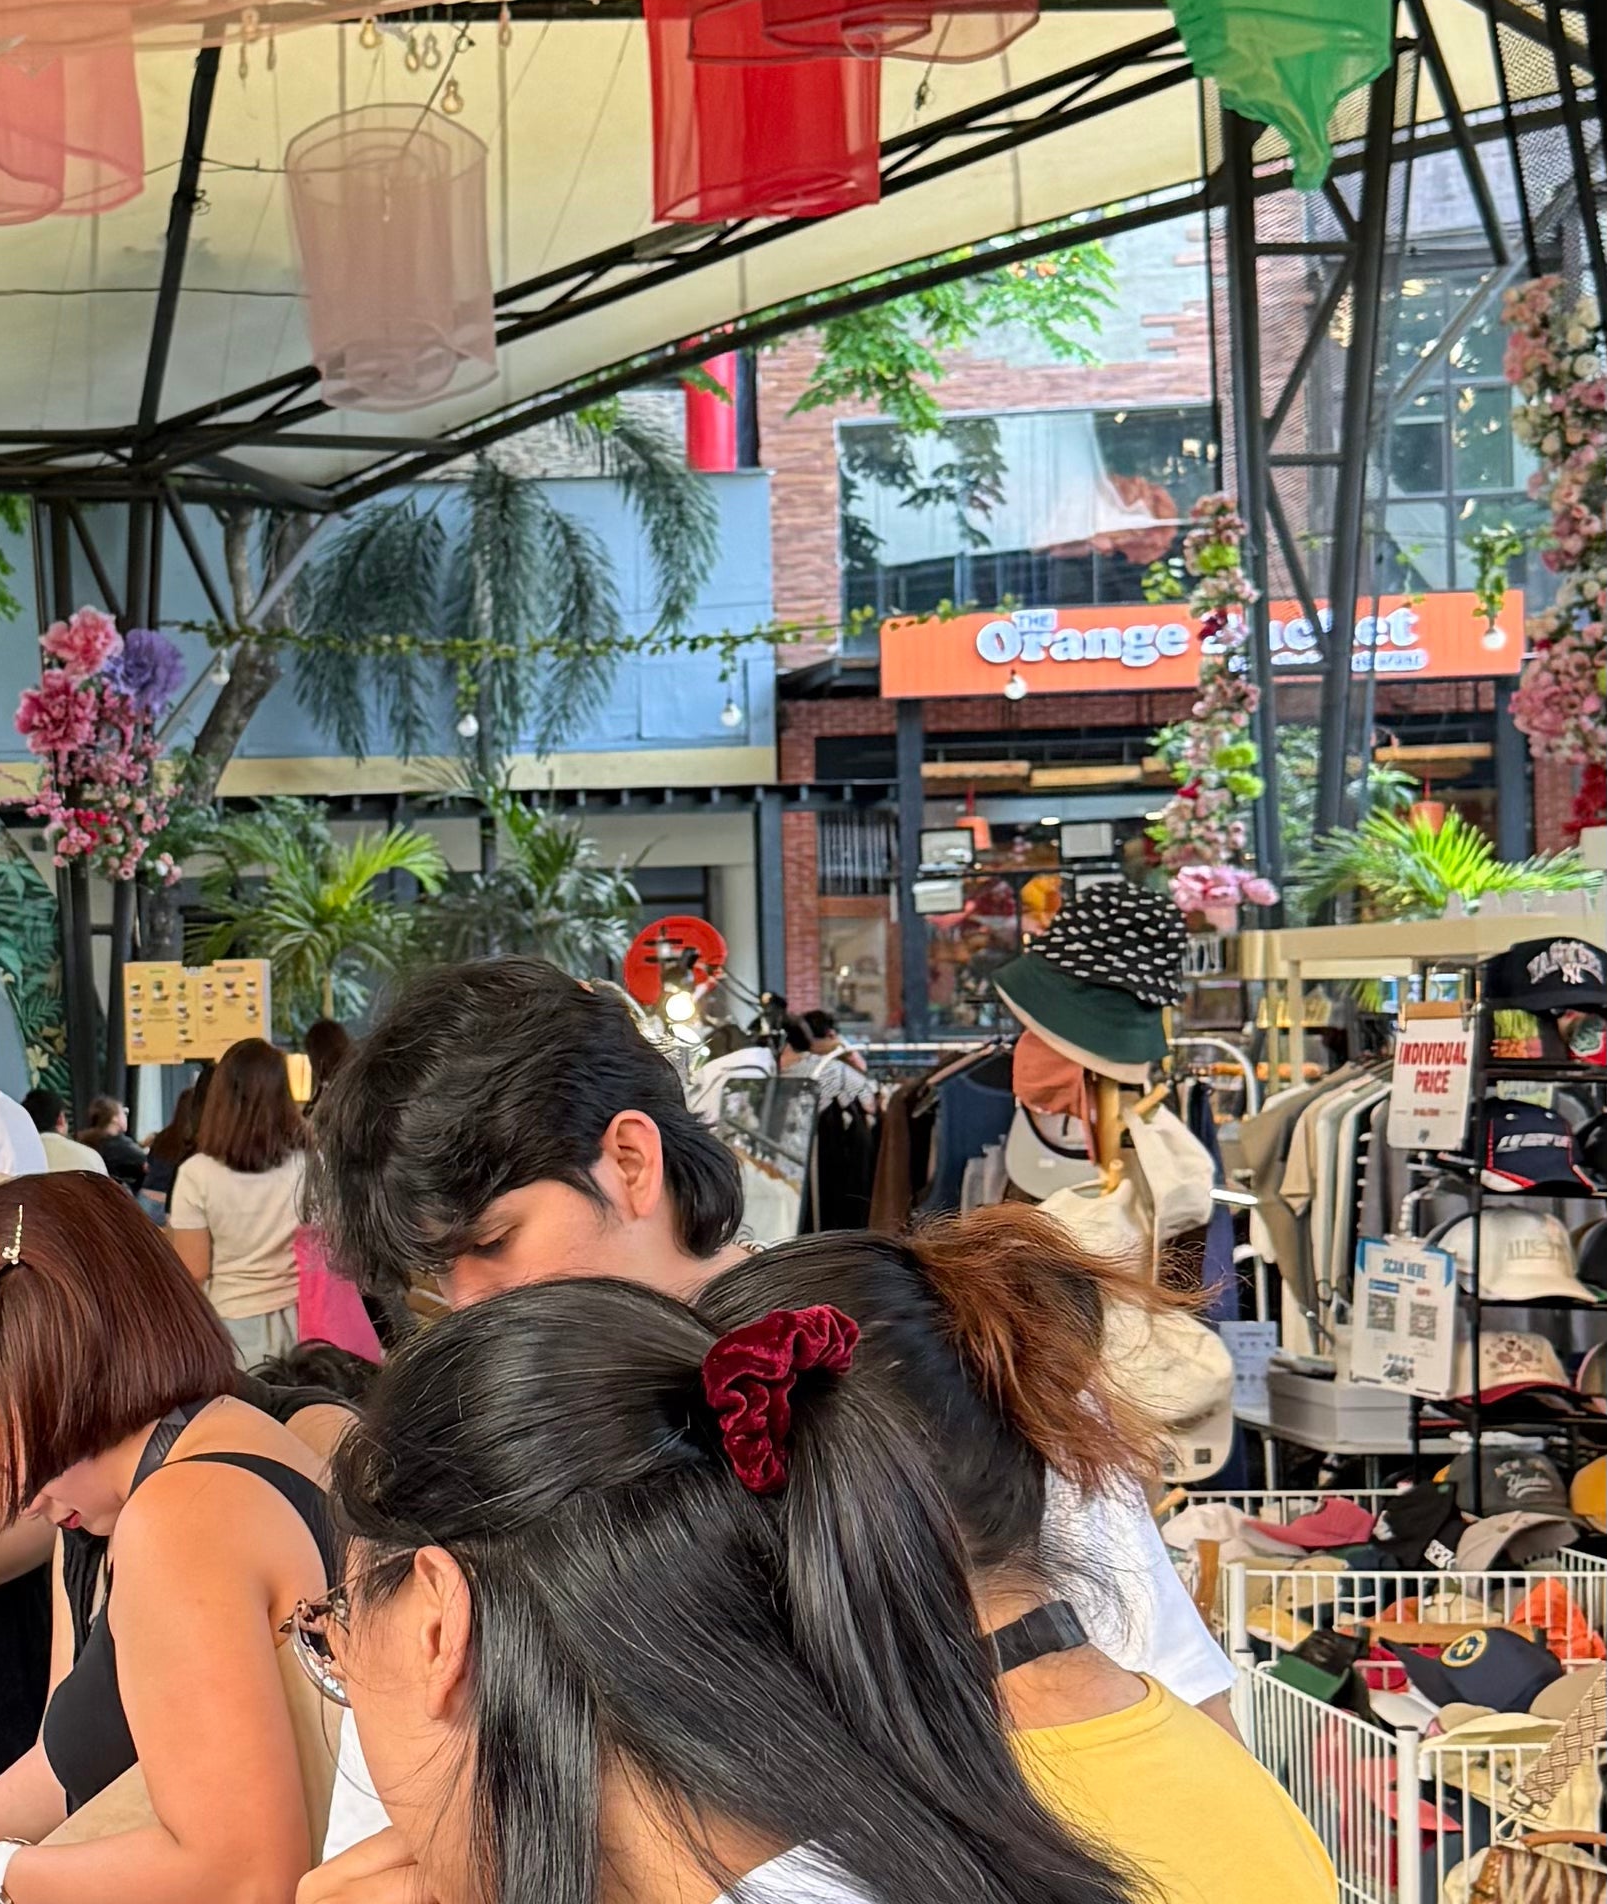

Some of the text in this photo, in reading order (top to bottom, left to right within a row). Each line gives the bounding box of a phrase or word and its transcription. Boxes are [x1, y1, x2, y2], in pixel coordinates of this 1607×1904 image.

[976, 619, 1192, 668] Orange
[1399, 1042, 1468, 1065] INDIVIDUAL
[1414, 1070, 1451, 1094] PRICE
